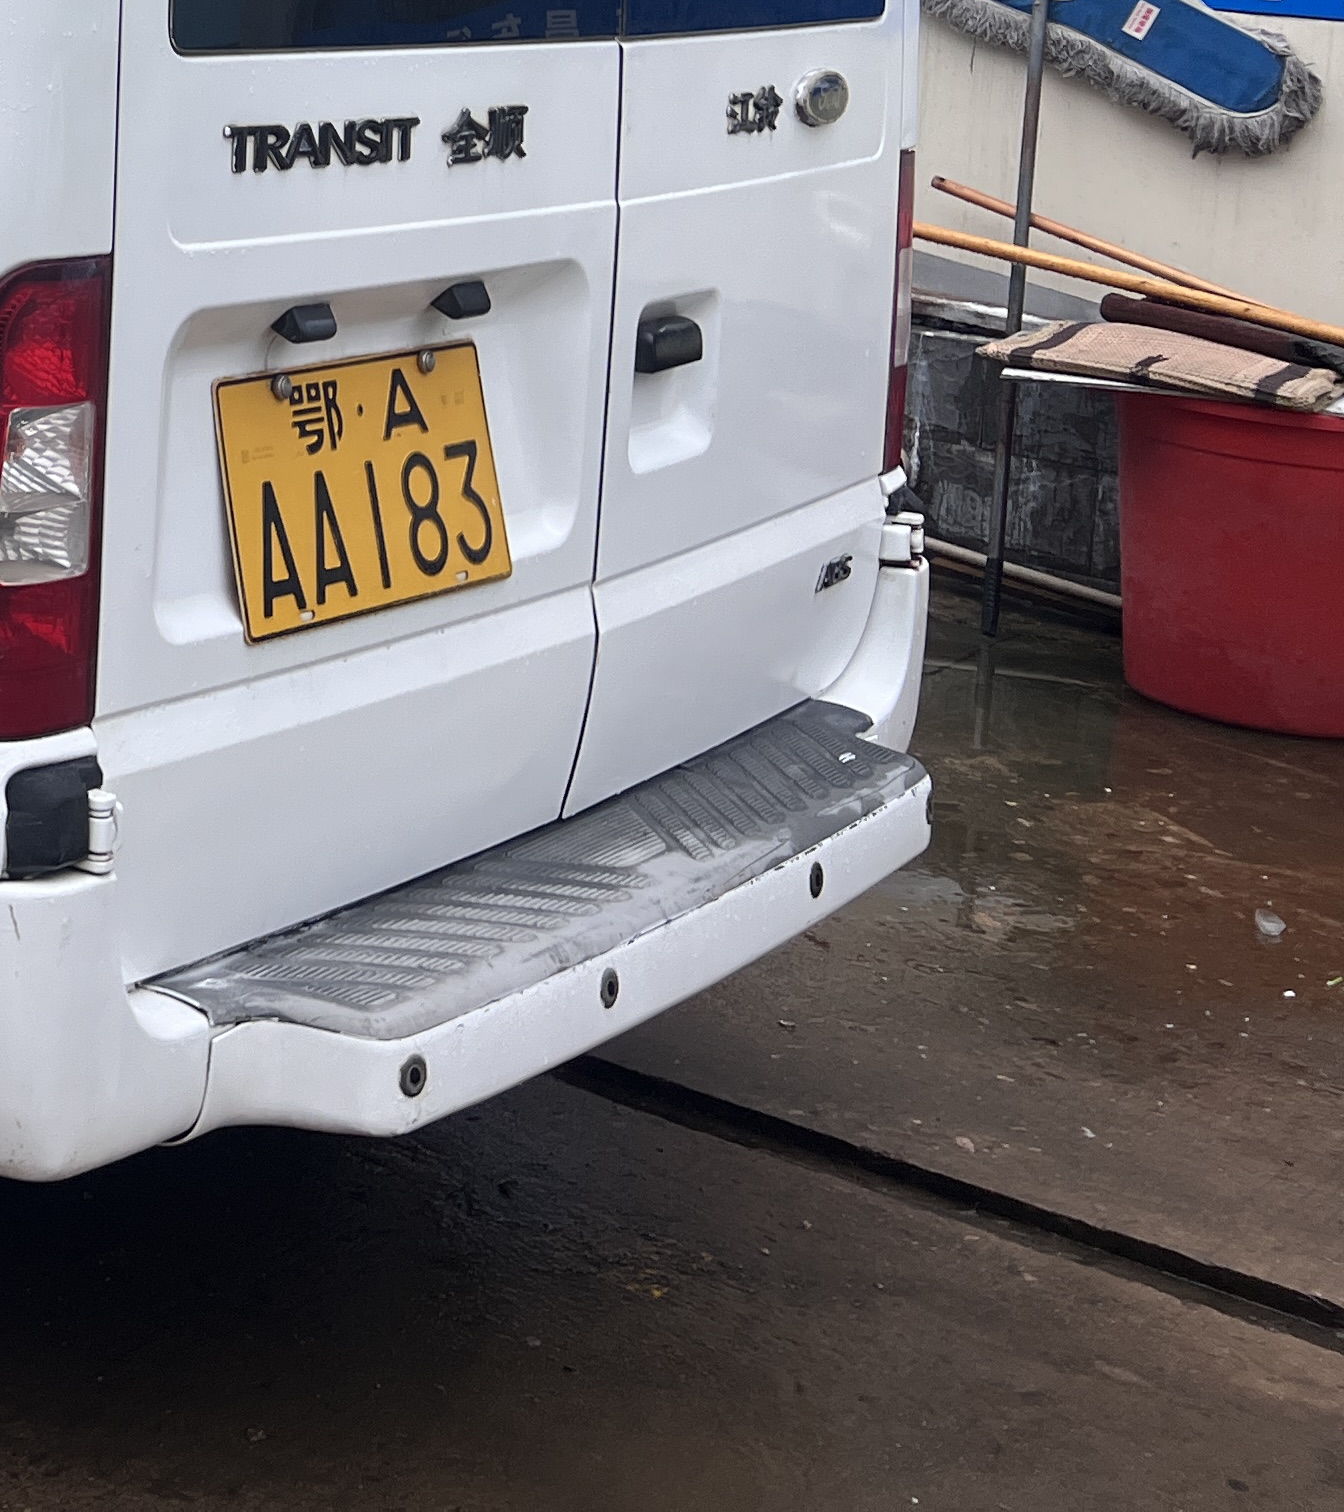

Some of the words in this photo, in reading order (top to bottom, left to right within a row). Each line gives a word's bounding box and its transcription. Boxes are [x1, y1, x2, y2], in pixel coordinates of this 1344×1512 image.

[726, 85, 783, 134] 江铃
[223, 116, 420, 173] TRANSIT
[441, 105, 529, 168] 全顺
[262, 440, 493, 619] AA183
[815, 553, 853, 593] ABS
